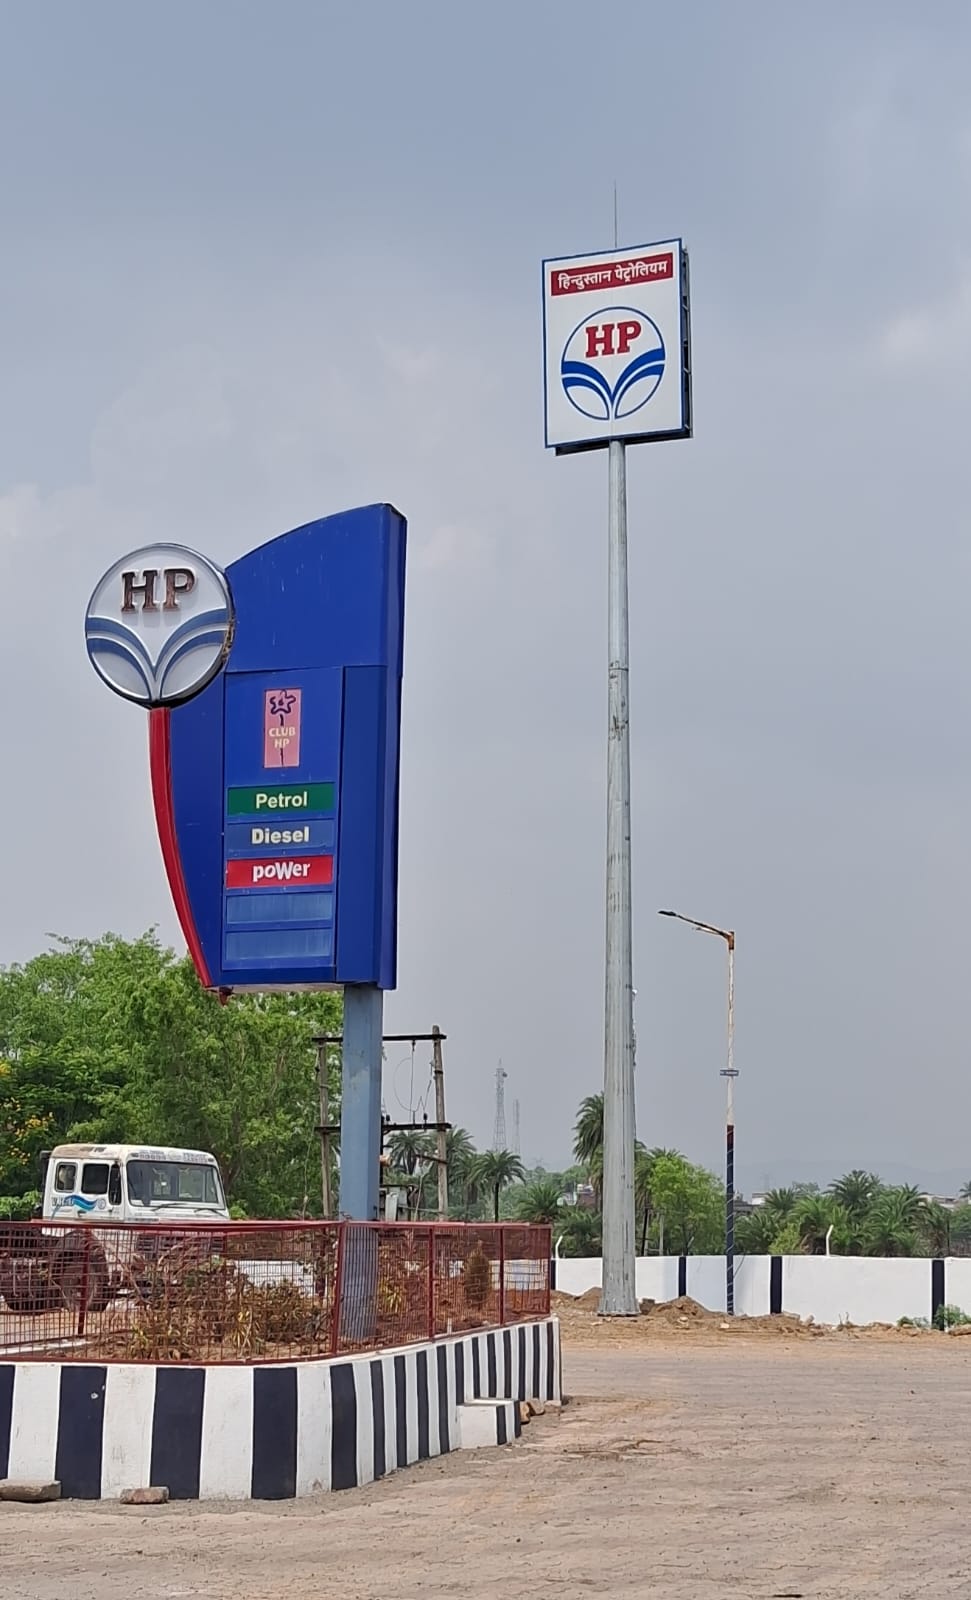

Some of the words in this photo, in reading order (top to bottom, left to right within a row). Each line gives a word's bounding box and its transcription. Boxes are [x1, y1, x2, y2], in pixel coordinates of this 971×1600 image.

[558, 269, 612, 290] हिन्दुस्तान
[614, 260, 668, 282] पेट्रोलियम
[585, 320, 642, 358] HP
[121, 568, 195, 612] HP
[268, 727, 296, 737] CLUB
[274, 738, 290, 749] HP
[255, 791, 308, 809] Petrol
[251, 826, 309, 844] Diesel
[252, 862, 311, 882] poWer
